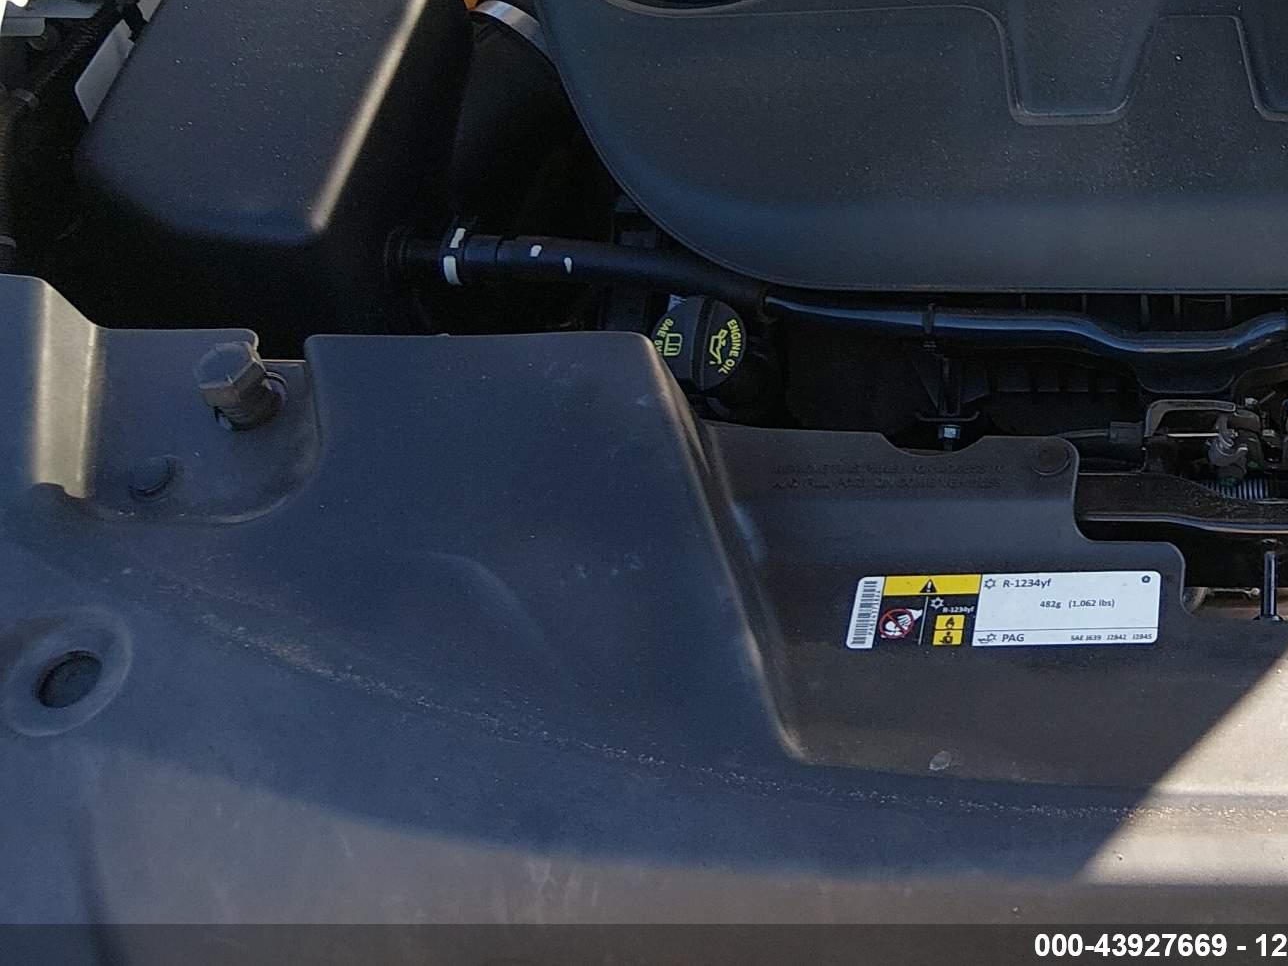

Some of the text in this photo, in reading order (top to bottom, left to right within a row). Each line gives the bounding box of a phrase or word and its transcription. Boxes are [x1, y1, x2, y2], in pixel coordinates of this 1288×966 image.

[718, 319, 742, 375] ENGINE OIL
[1002, 577, 1052, 589] R-1234yf
[942, 605, 975, 614] R-1234yf
[1040, 598, 1116, 610] 482g (1.062 lbs)
[1001, 633, 1025, 643] PAG
